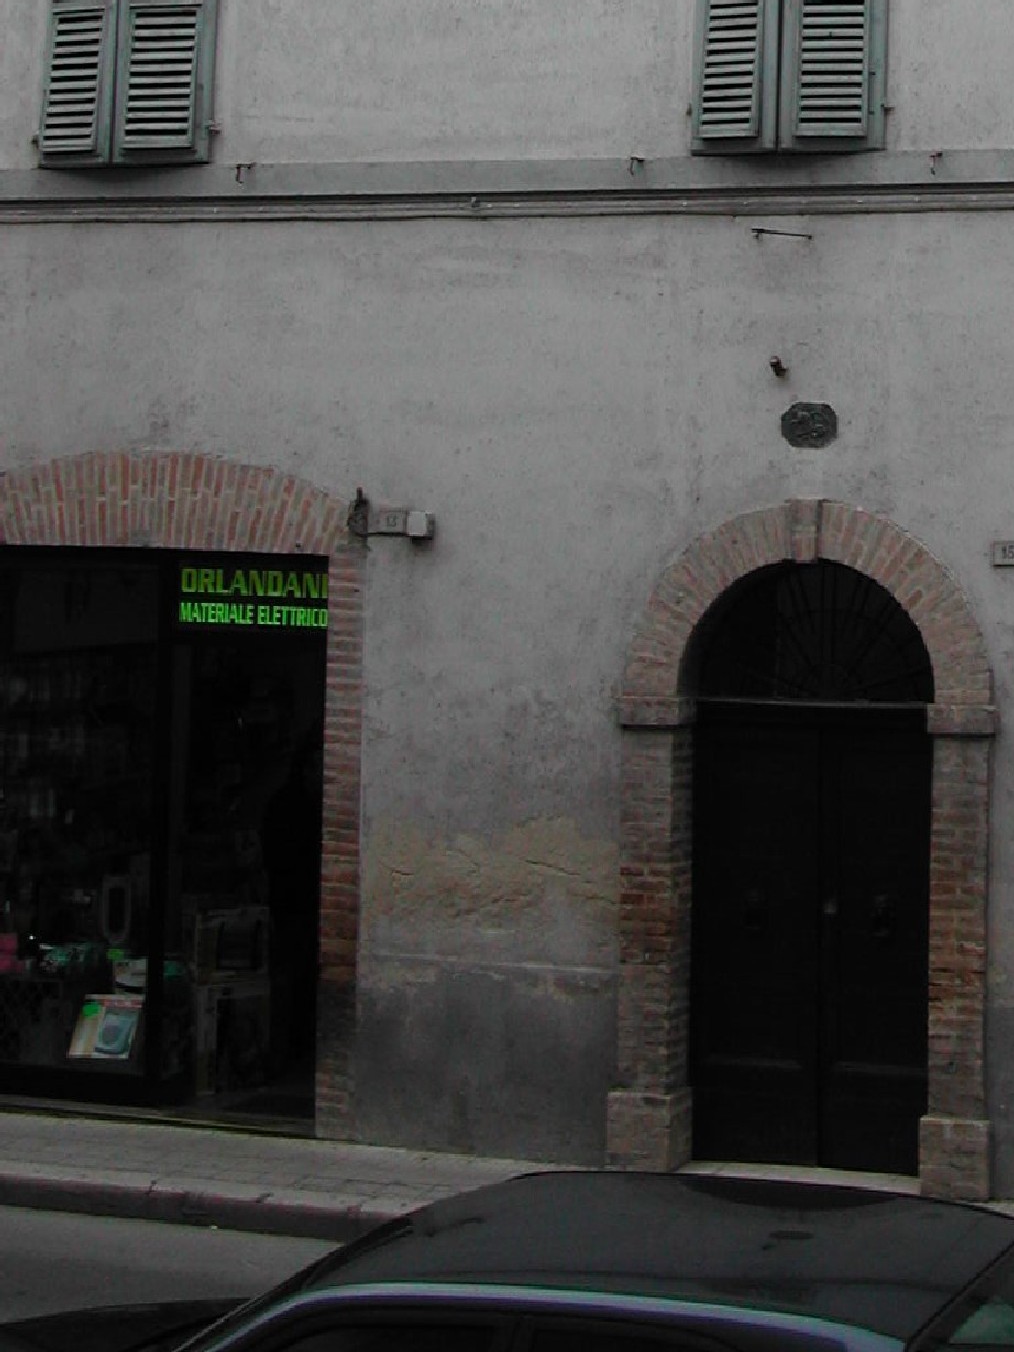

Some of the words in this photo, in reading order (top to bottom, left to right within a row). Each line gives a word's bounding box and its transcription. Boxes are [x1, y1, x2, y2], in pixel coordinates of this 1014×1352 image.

[181, 568, 328, 599] ORLANDANI
[179, 602, 254, 625] MATERIALE
[256, 604, 328, 628] ELETTRICO
